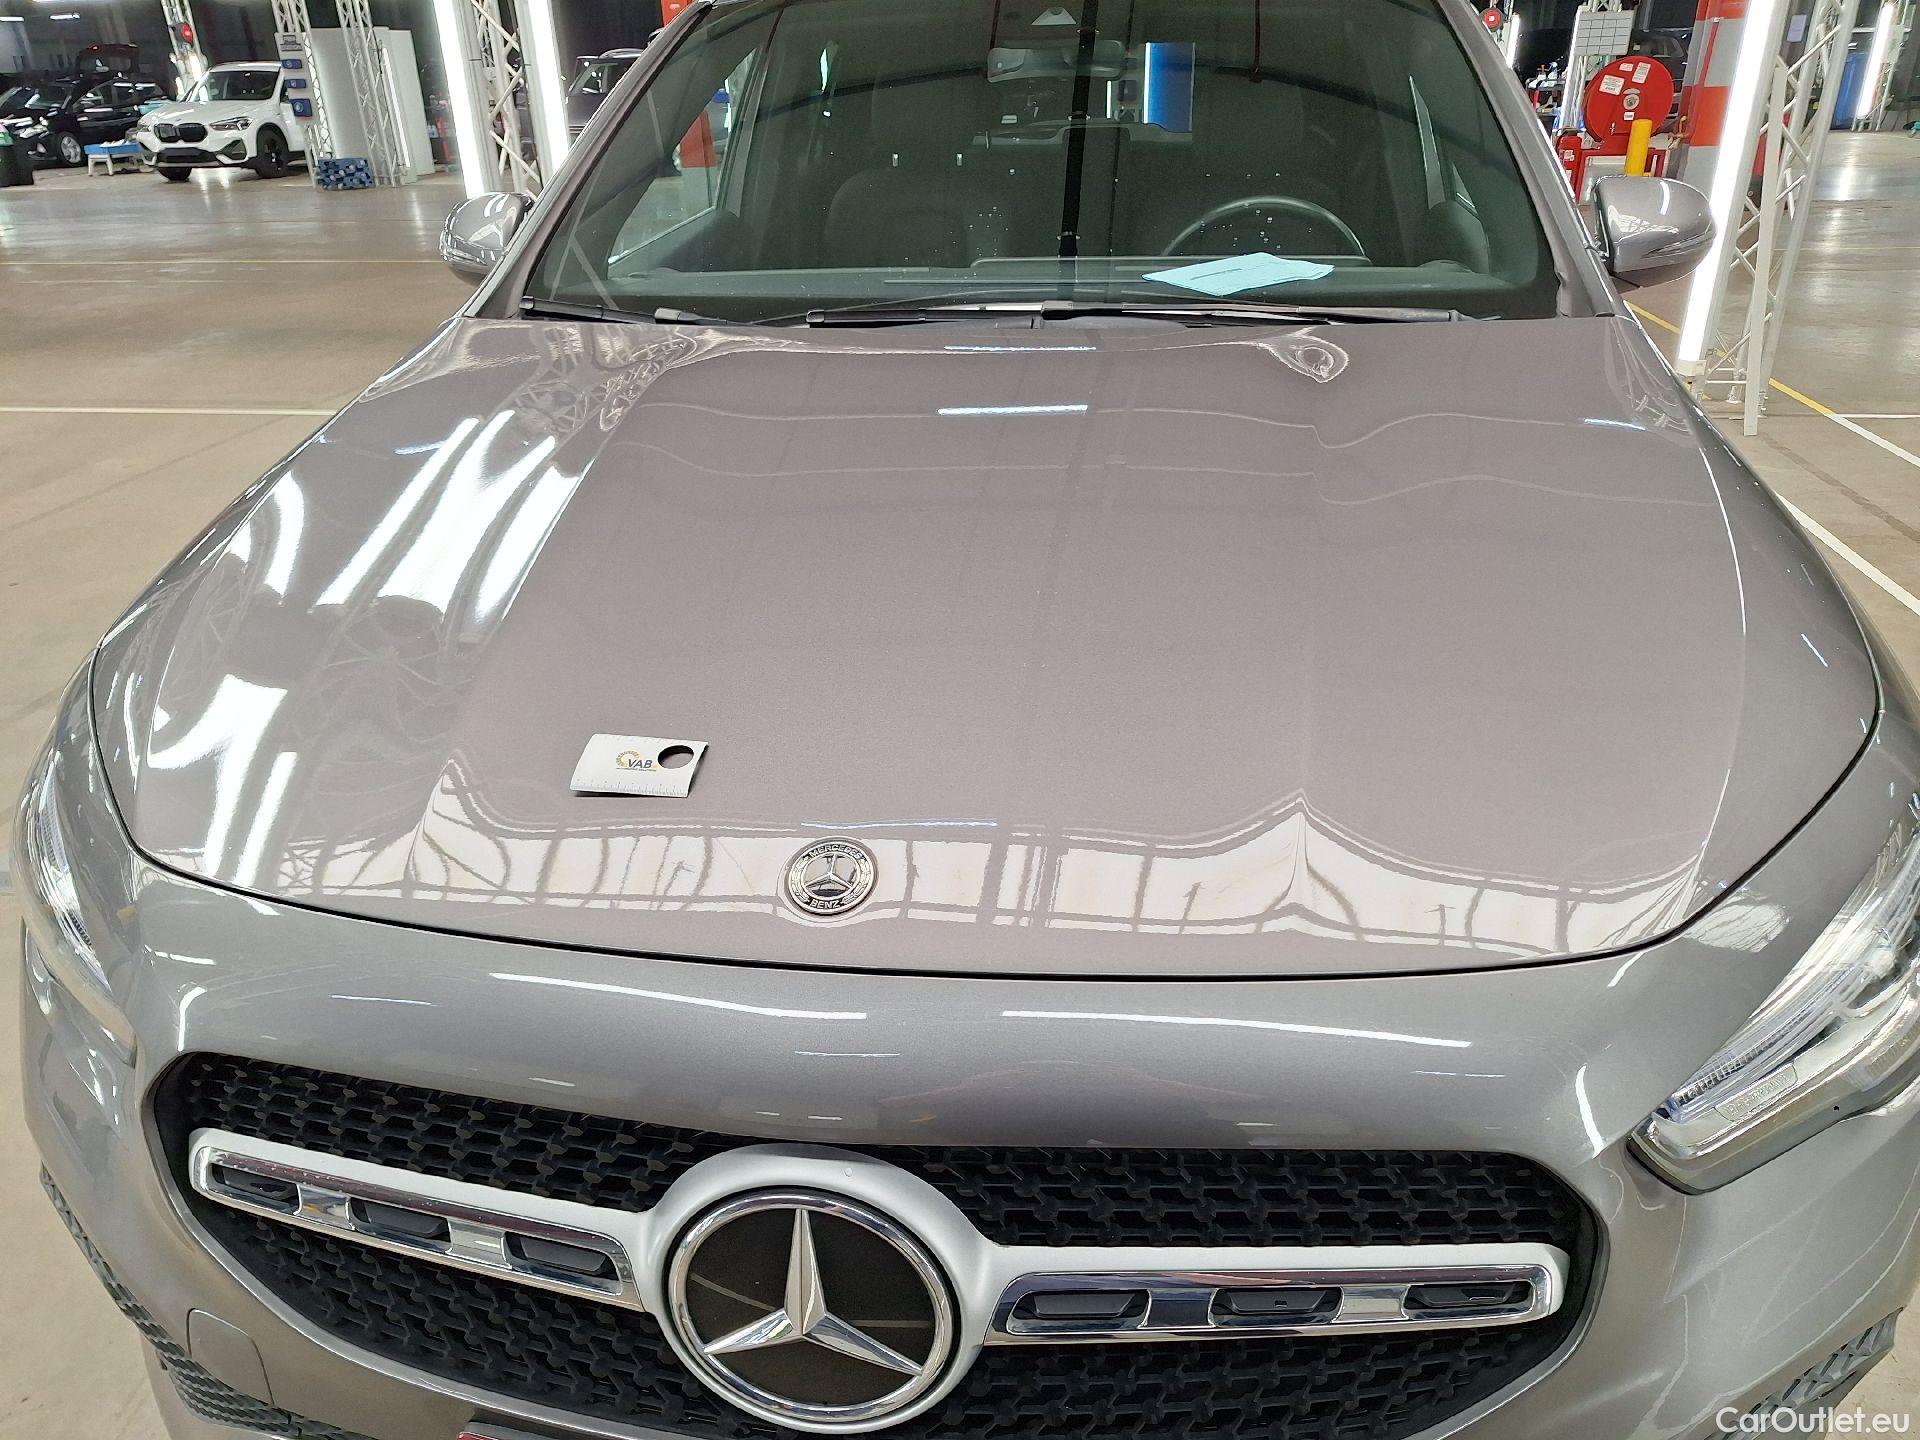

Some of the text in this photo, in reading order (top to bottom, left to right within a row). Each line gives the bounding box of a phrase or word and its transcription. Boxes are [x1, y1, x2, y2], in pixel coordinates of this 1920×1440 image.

[628, 758, 653, 769] VAB
[809, 844, 863, 861] MERCEDES
[809, 898, 841, 910] BENZ
